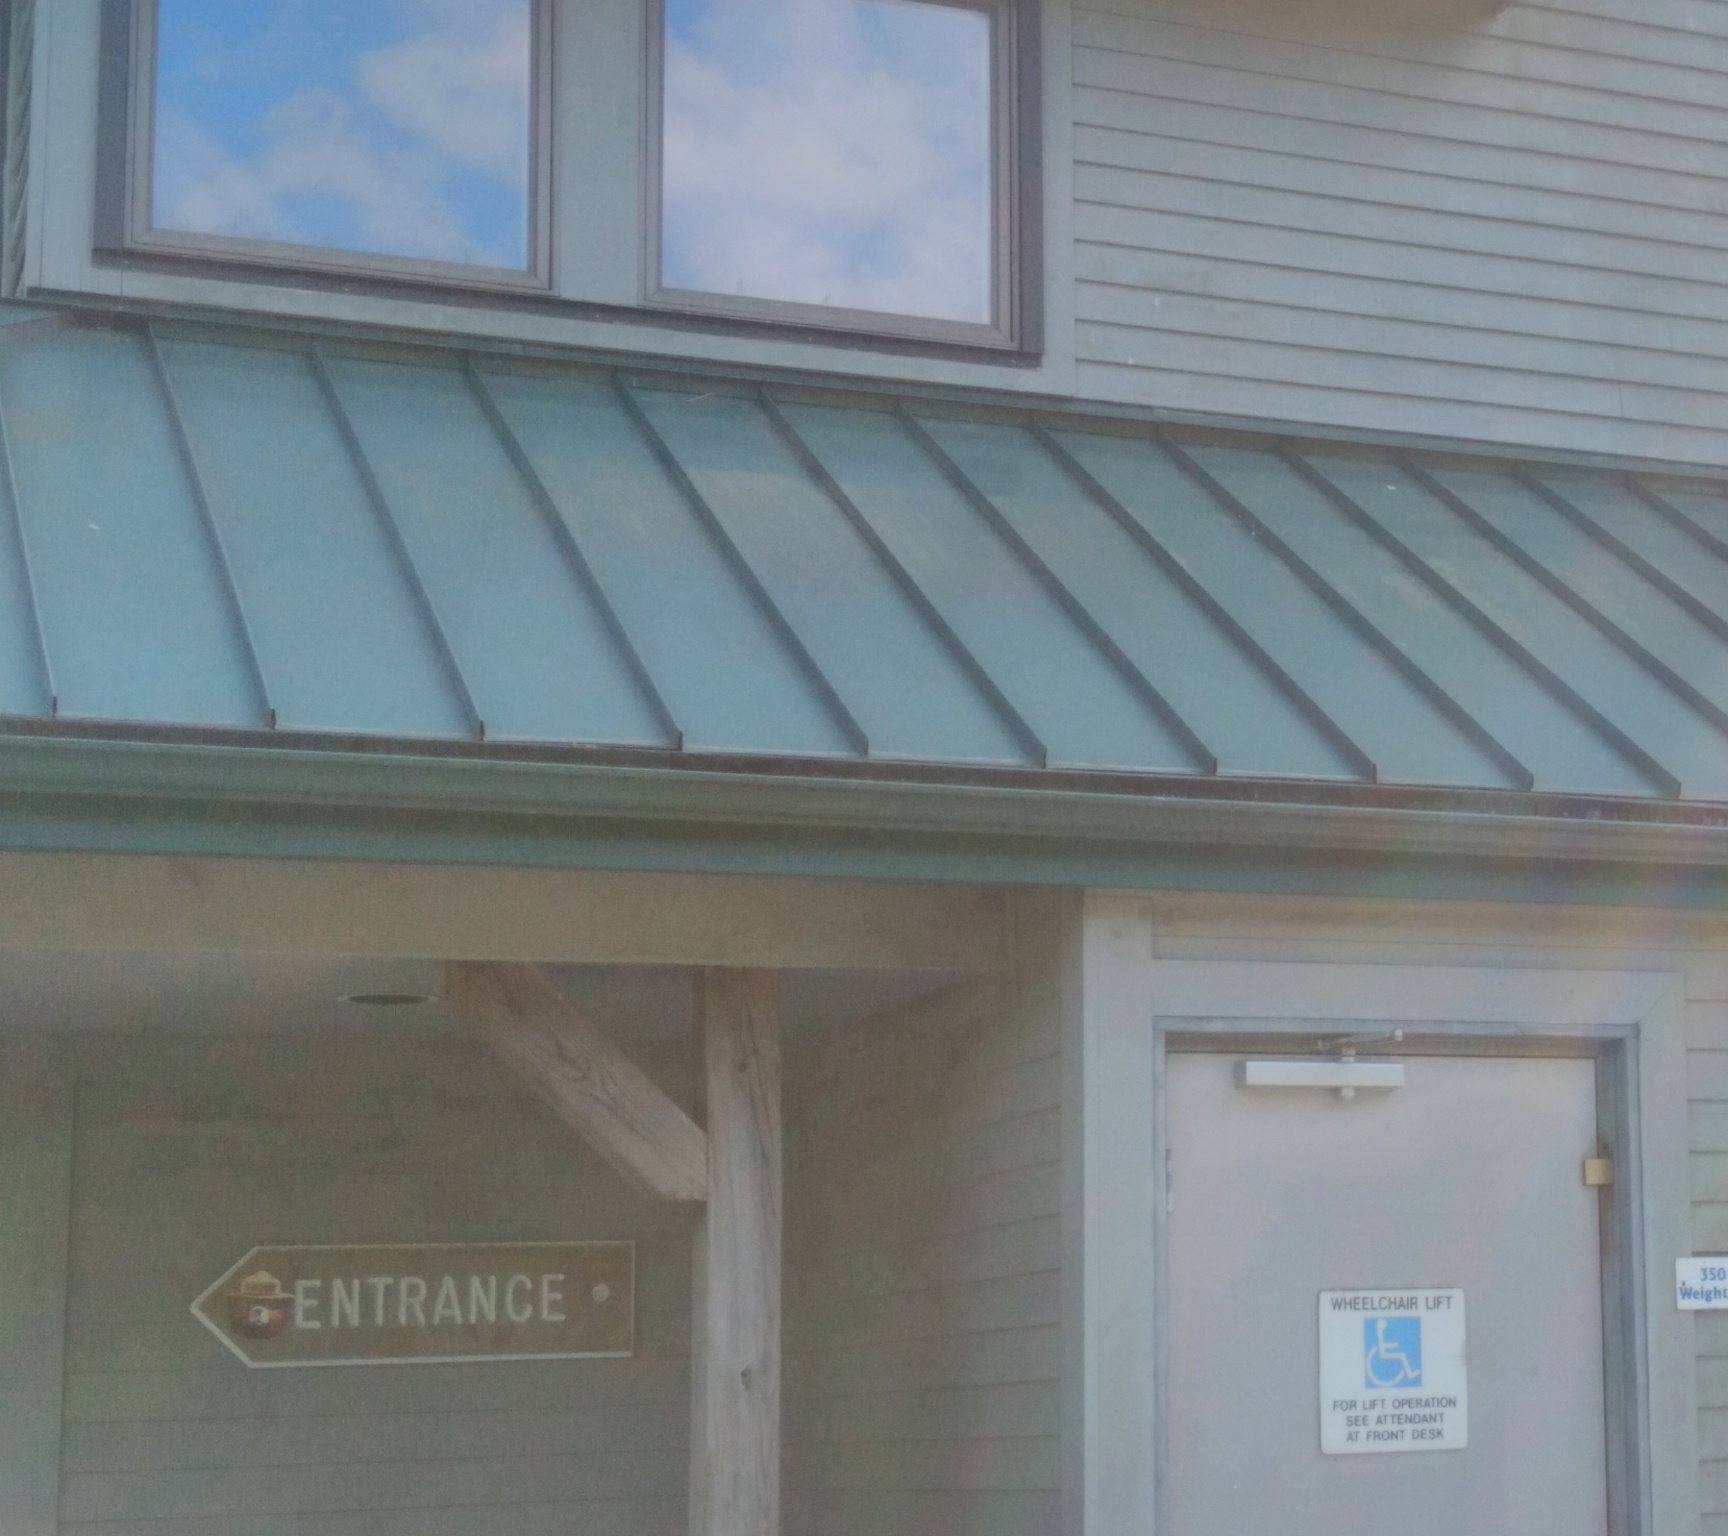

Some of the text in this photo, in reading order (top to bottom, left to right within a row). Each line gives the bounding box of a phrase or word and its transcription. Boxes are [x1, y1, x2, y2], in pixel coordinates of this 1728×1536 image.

[1700, 1267, 1727, 1282] 350
[294, 1273, 567, 1330] ENTRANCE
[1679, 1286, 1728, 1303] Weight
[1331, 1296, 1453, 1311] WHEELCHAIR LIFT
[1333, 1397, 1457, 1411] FOR LIFT OPERATION
[1345, 1413, 1445, 1427] SEE ATTENDANT
[1346, 1428, 1445, 1443] AT FRONT DESK
